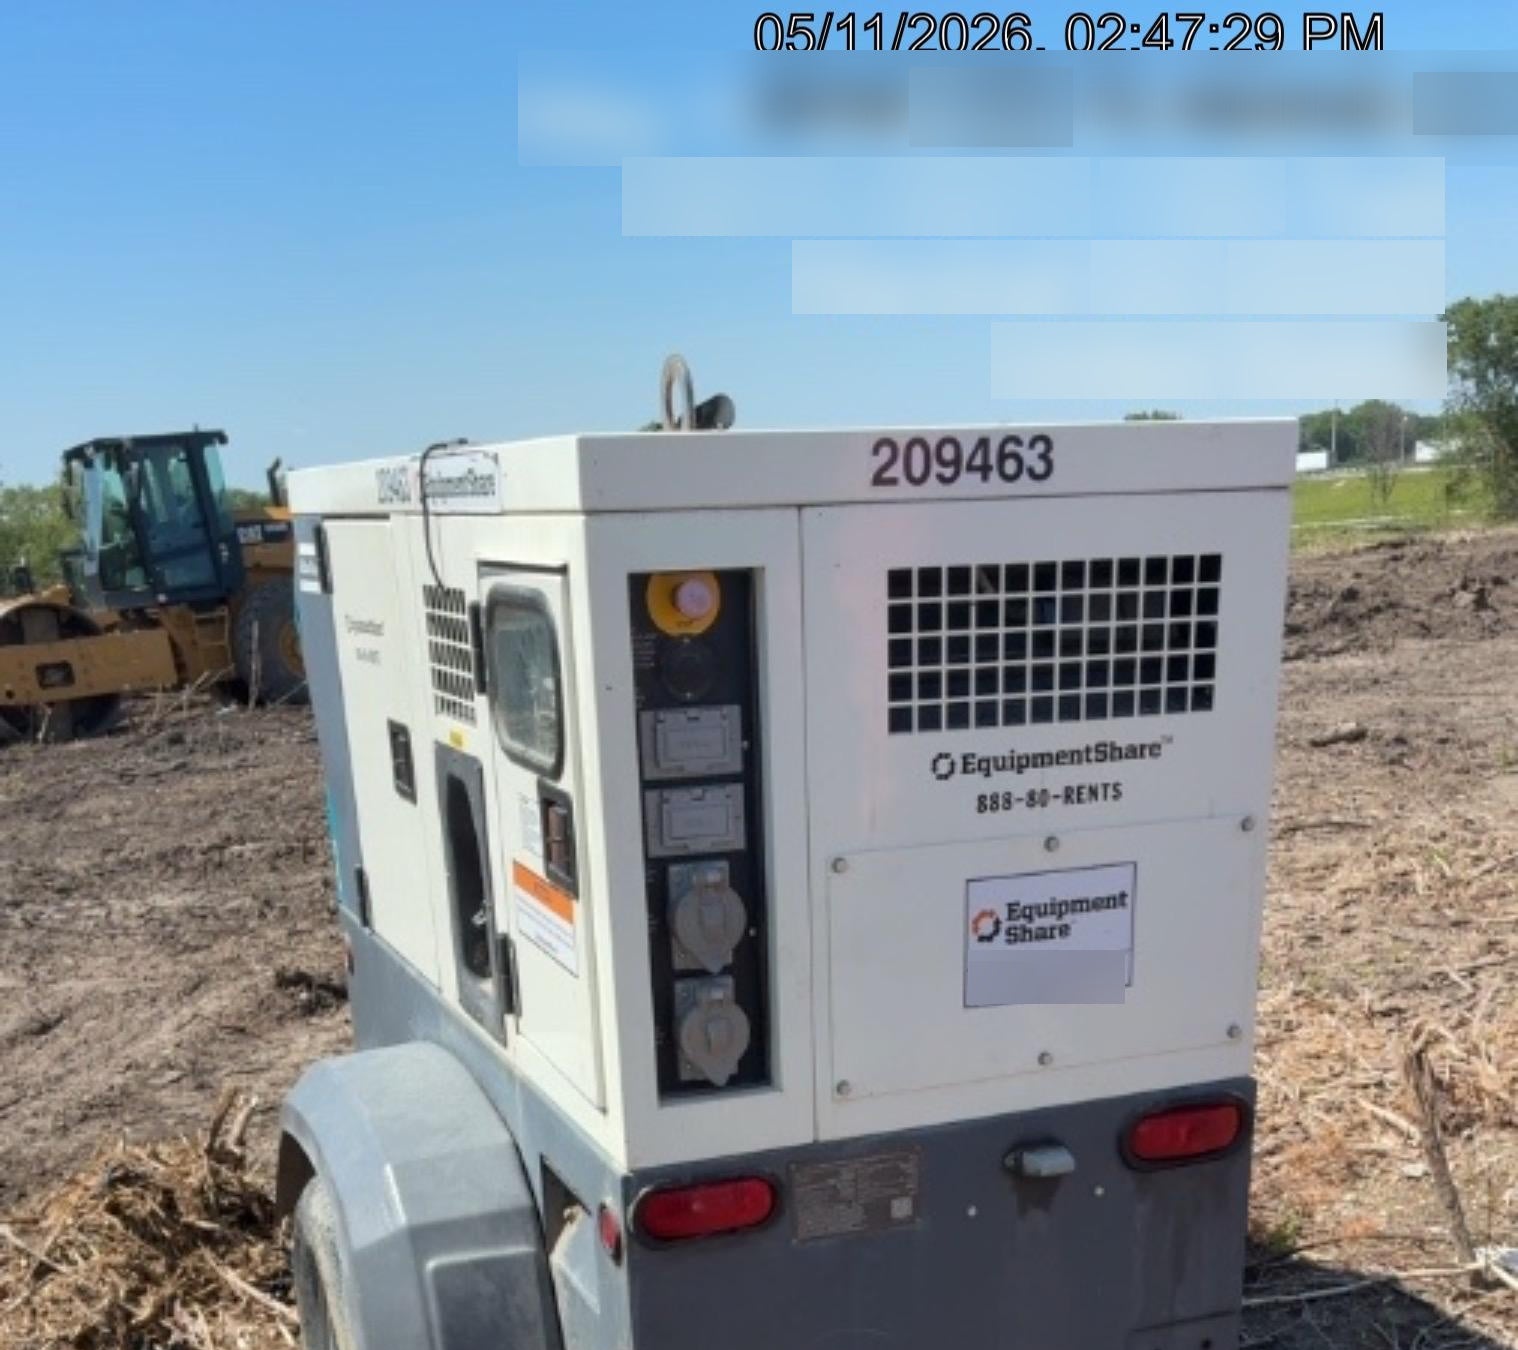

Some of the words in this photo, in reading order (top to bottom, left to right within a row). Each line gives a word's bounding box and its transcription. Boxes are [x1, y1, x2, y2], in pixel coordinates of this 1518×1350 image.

[872, 434, 1054, 487] 209463
[977, 782, 1123, 813] 888-80-RENTS
[1005, 890, 1129, 924] Equipment
[1004, 923, 1072, 945] Share
